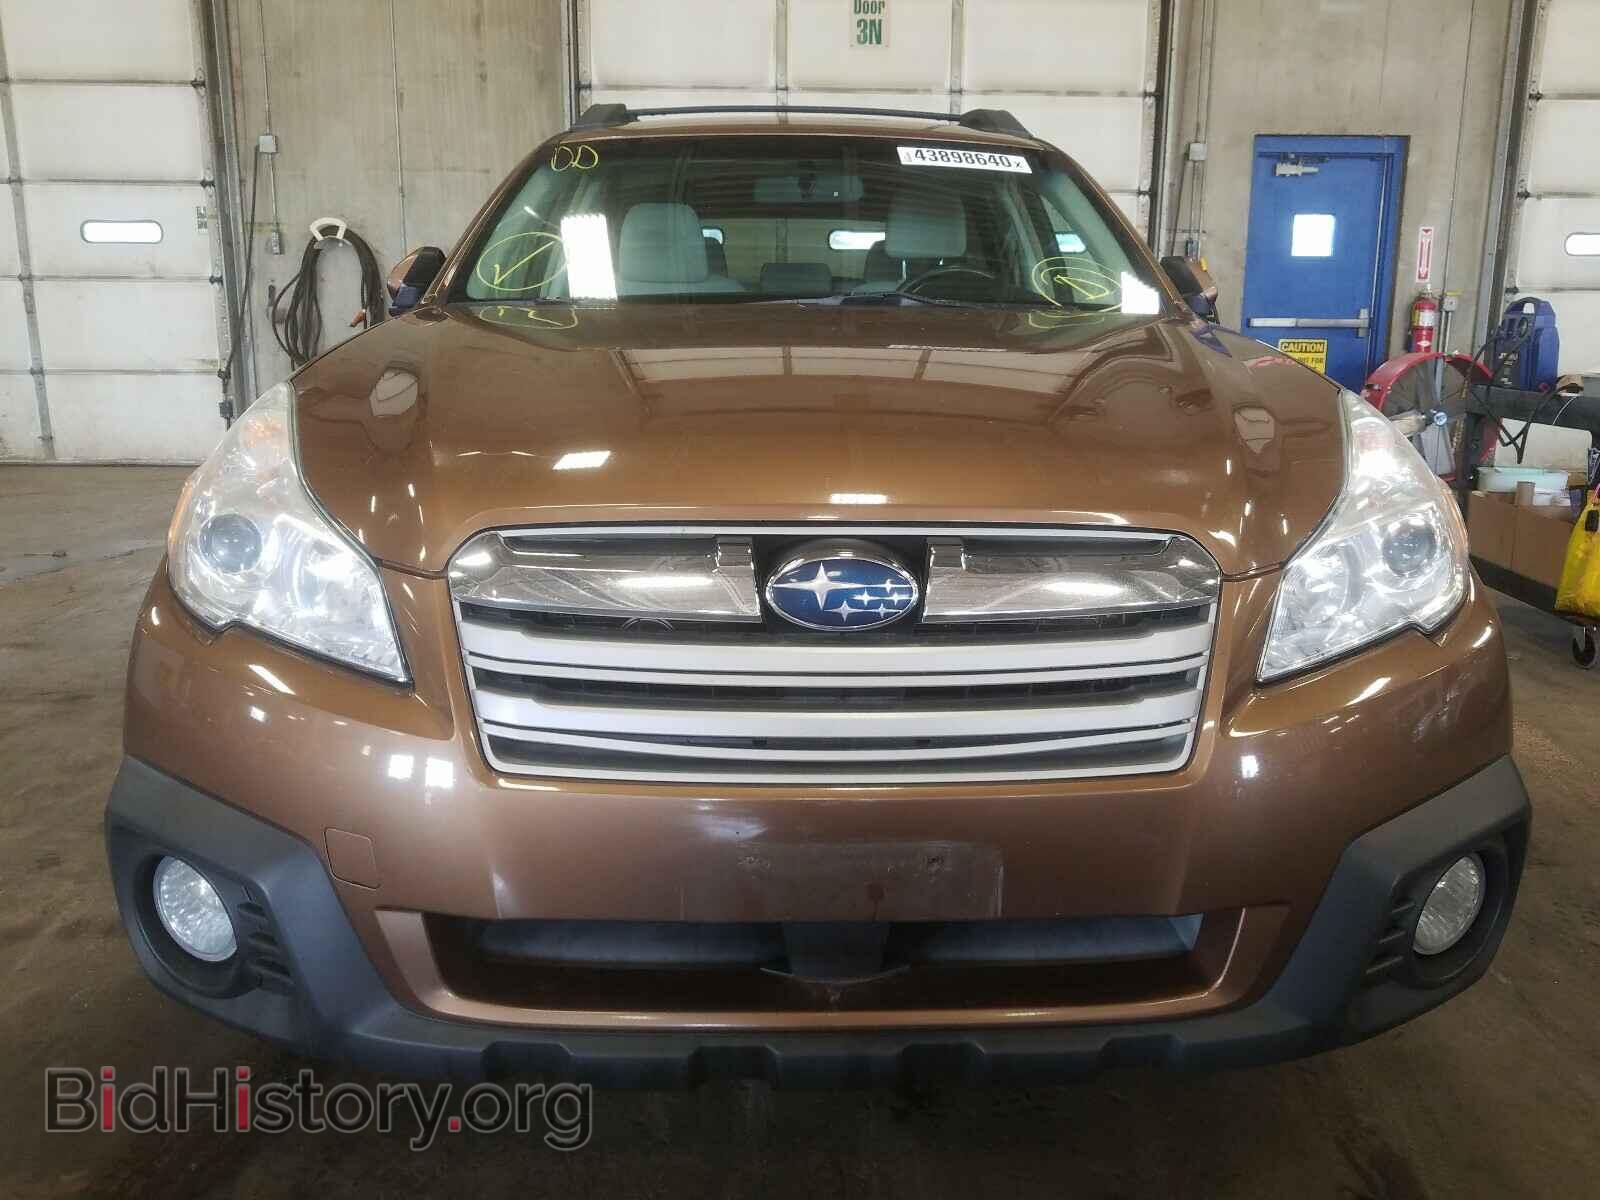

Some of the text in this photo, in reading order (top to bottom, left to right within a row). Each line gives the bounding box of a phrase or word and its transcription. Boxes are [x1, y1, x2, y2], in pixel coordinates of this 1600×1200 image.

[854, 0, 885, 14] Door
[856, 18, 882, 45] 3N
[914, 149, 1012, 168] 43898640
[1282, 342, 1324, 352] CAUTION
